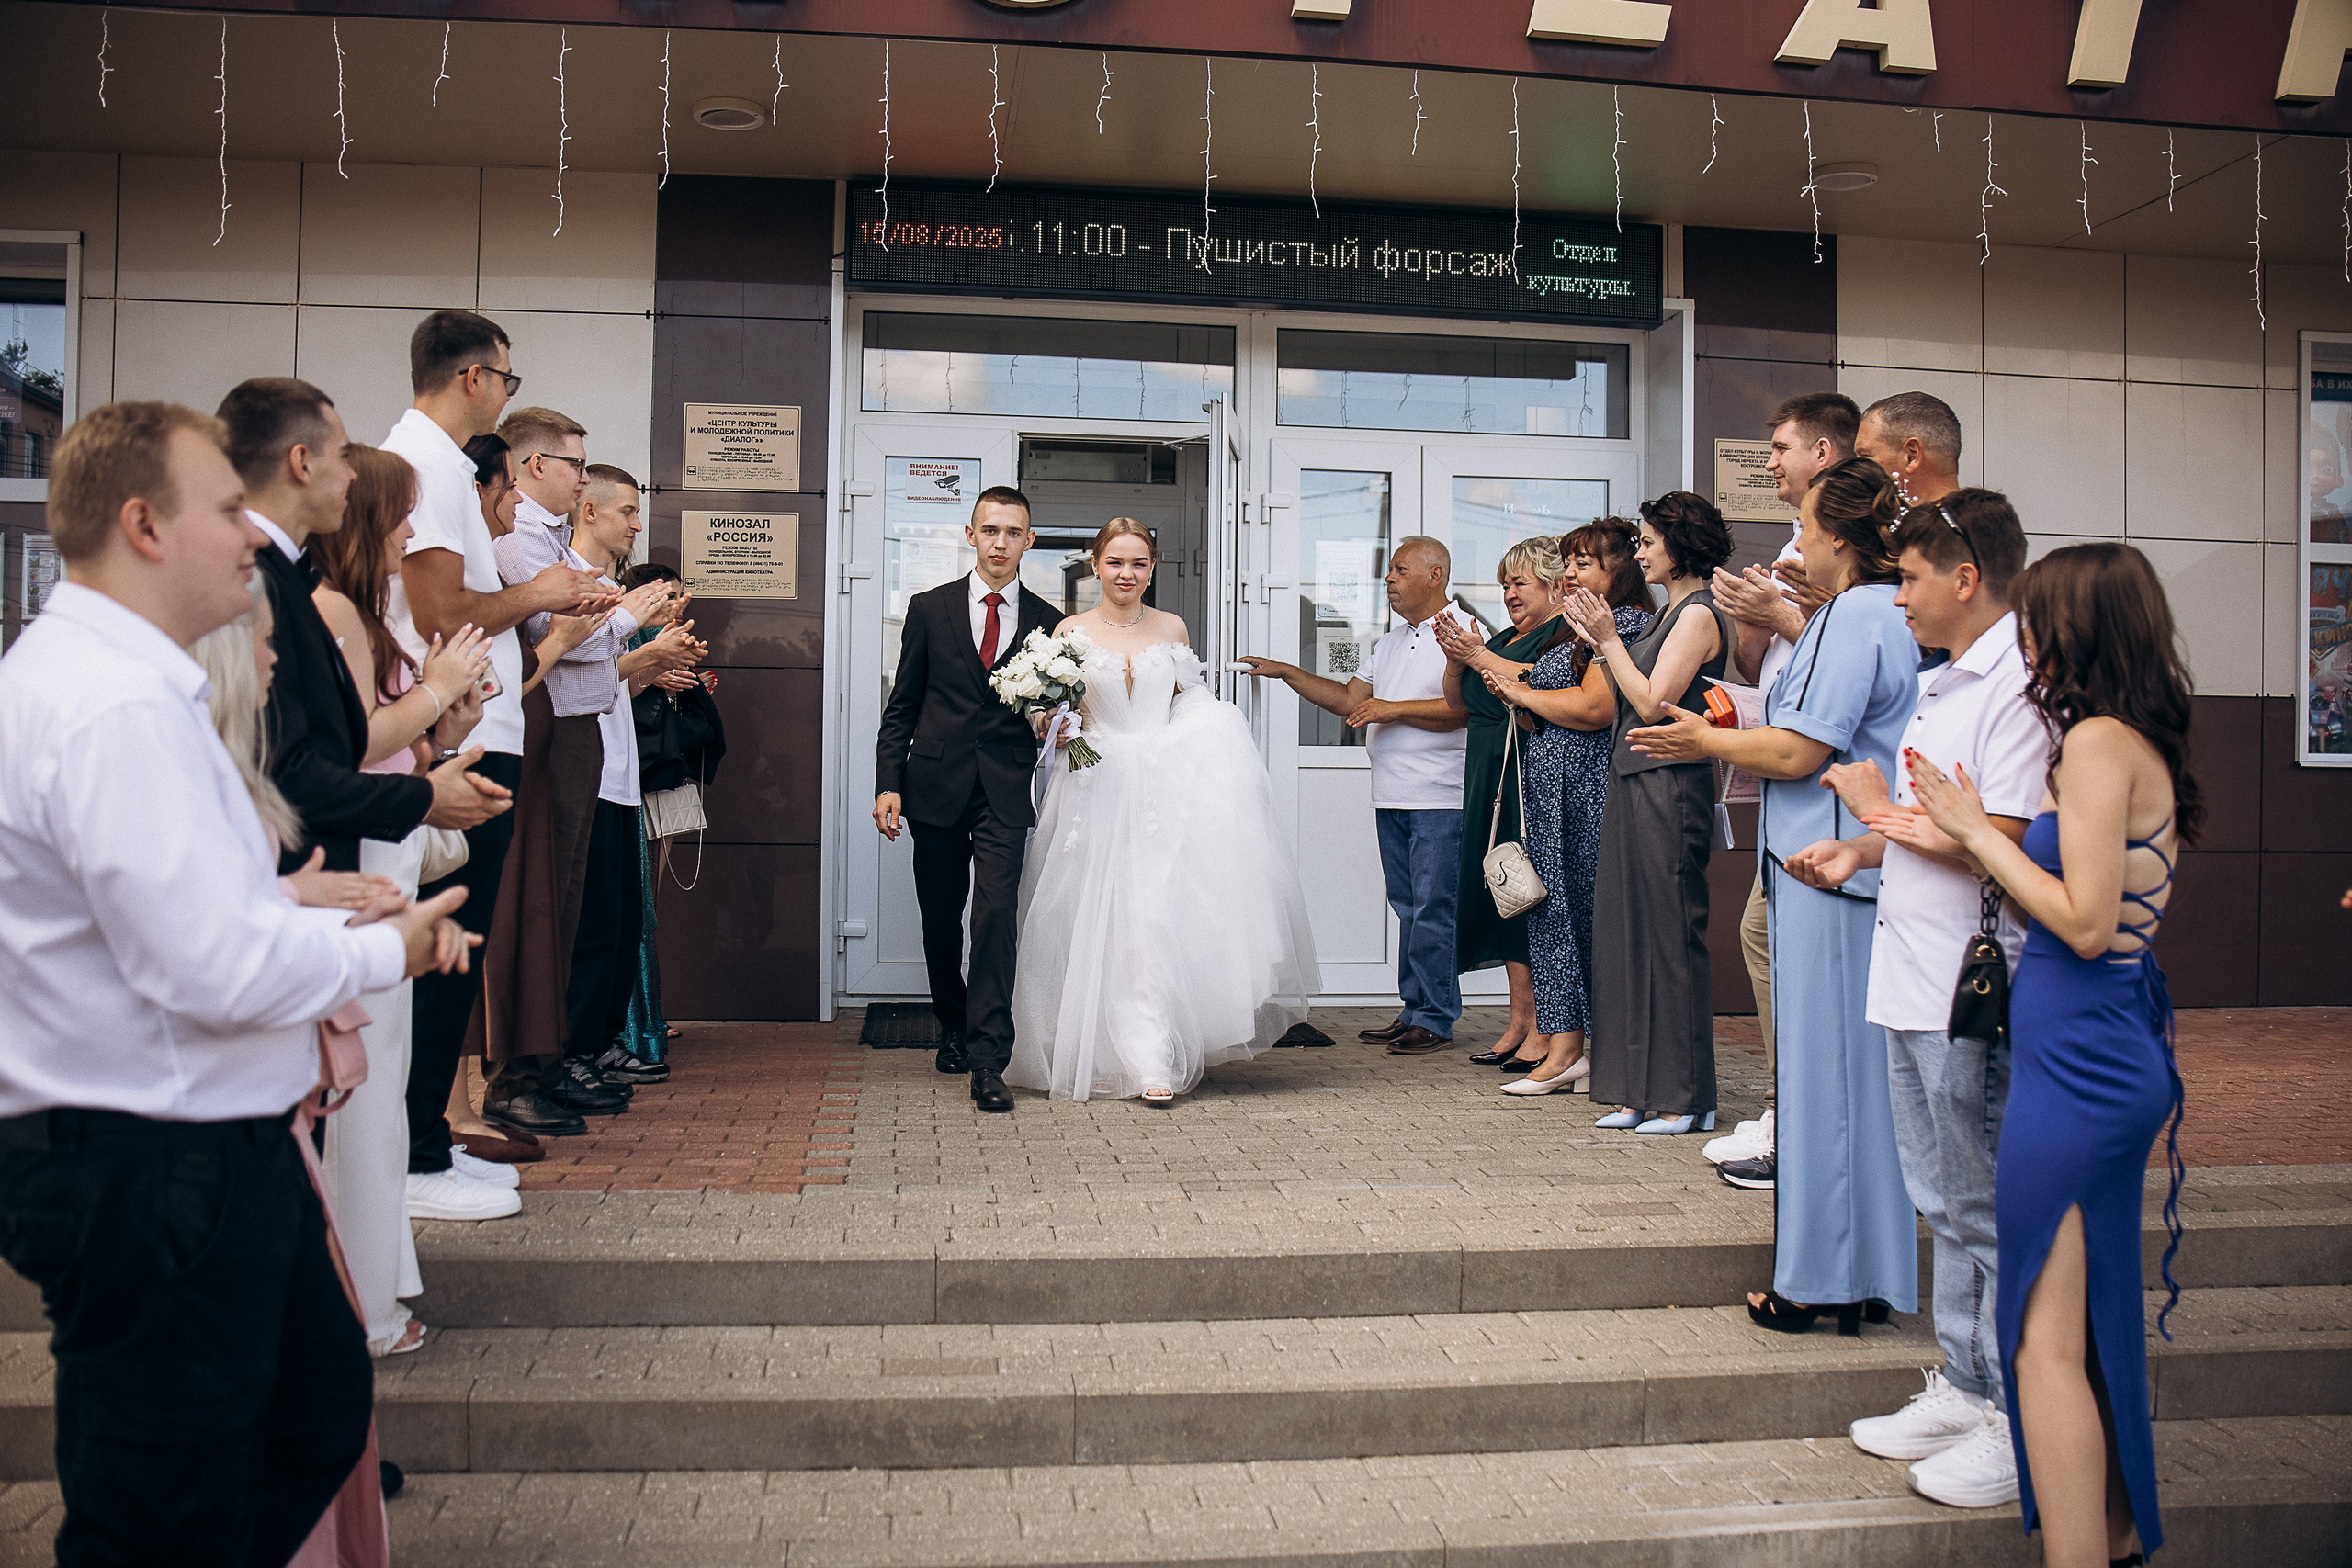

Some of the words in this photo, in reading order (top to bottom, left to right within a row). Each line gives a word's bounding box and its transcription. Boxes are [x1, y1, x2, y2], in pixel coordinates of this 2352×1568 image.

[1167, 227, 1359, 270] Пушистый
[1374, 238, 1512, 281] форсаж
[1553, 238, 1618, 263] Отдел
[1526, 275, 1636, 299] культуры.
[697, 427, 752, 435] МОЛОДЕЖНОЙ
[910, 463, 959, 471] ВНИМАНИЕ!
[710, 518, 771, 529] КИНОЗАЛ
[707, 532, 774, 543] «РОССИЯ»
